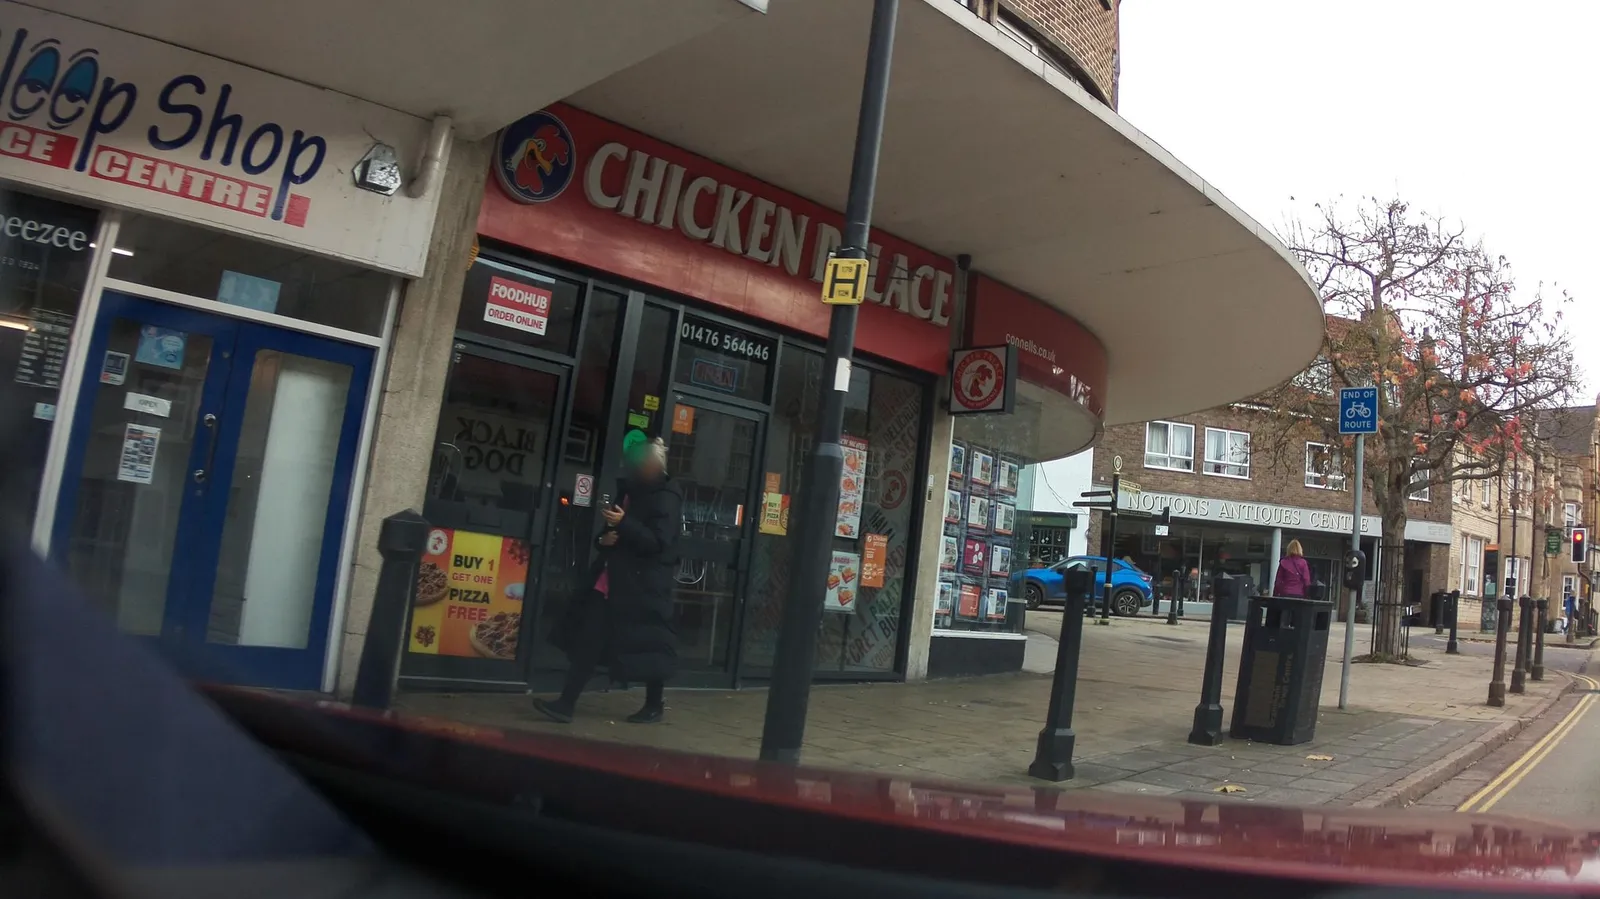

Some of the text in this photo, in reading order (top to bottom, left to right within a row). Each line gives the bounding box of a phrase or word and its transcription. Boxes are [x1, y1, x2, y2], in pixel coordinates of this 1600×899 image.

[0, 27, 327, 221] leep Shop
[95, 153, 271, 215] CENTRE
[585, 142, 953, 328] CHICKEN PLACE
[829, 263, 862, 299] H
[491, 283, 548, 310] FOODHUB
[488, 308, 544, 330] ORDER ONLINE
[681, 322, 769, 361] 01476 564646
[1005, 333, 1056, 363] connells.co.uk
[1343, 390, 1375, 399] END OF
[1344, 420, 1372, 429] ROUTE
[1127, 493, 1369, 533] NOTIONS ANTIQUES CENTE
[453, 554, 495, 571] BUY 1
[452, 572, 493, 585] GET ONE
[449, 588, 490, 604] PIZZA
[447, 605, 488, 621] FREE
